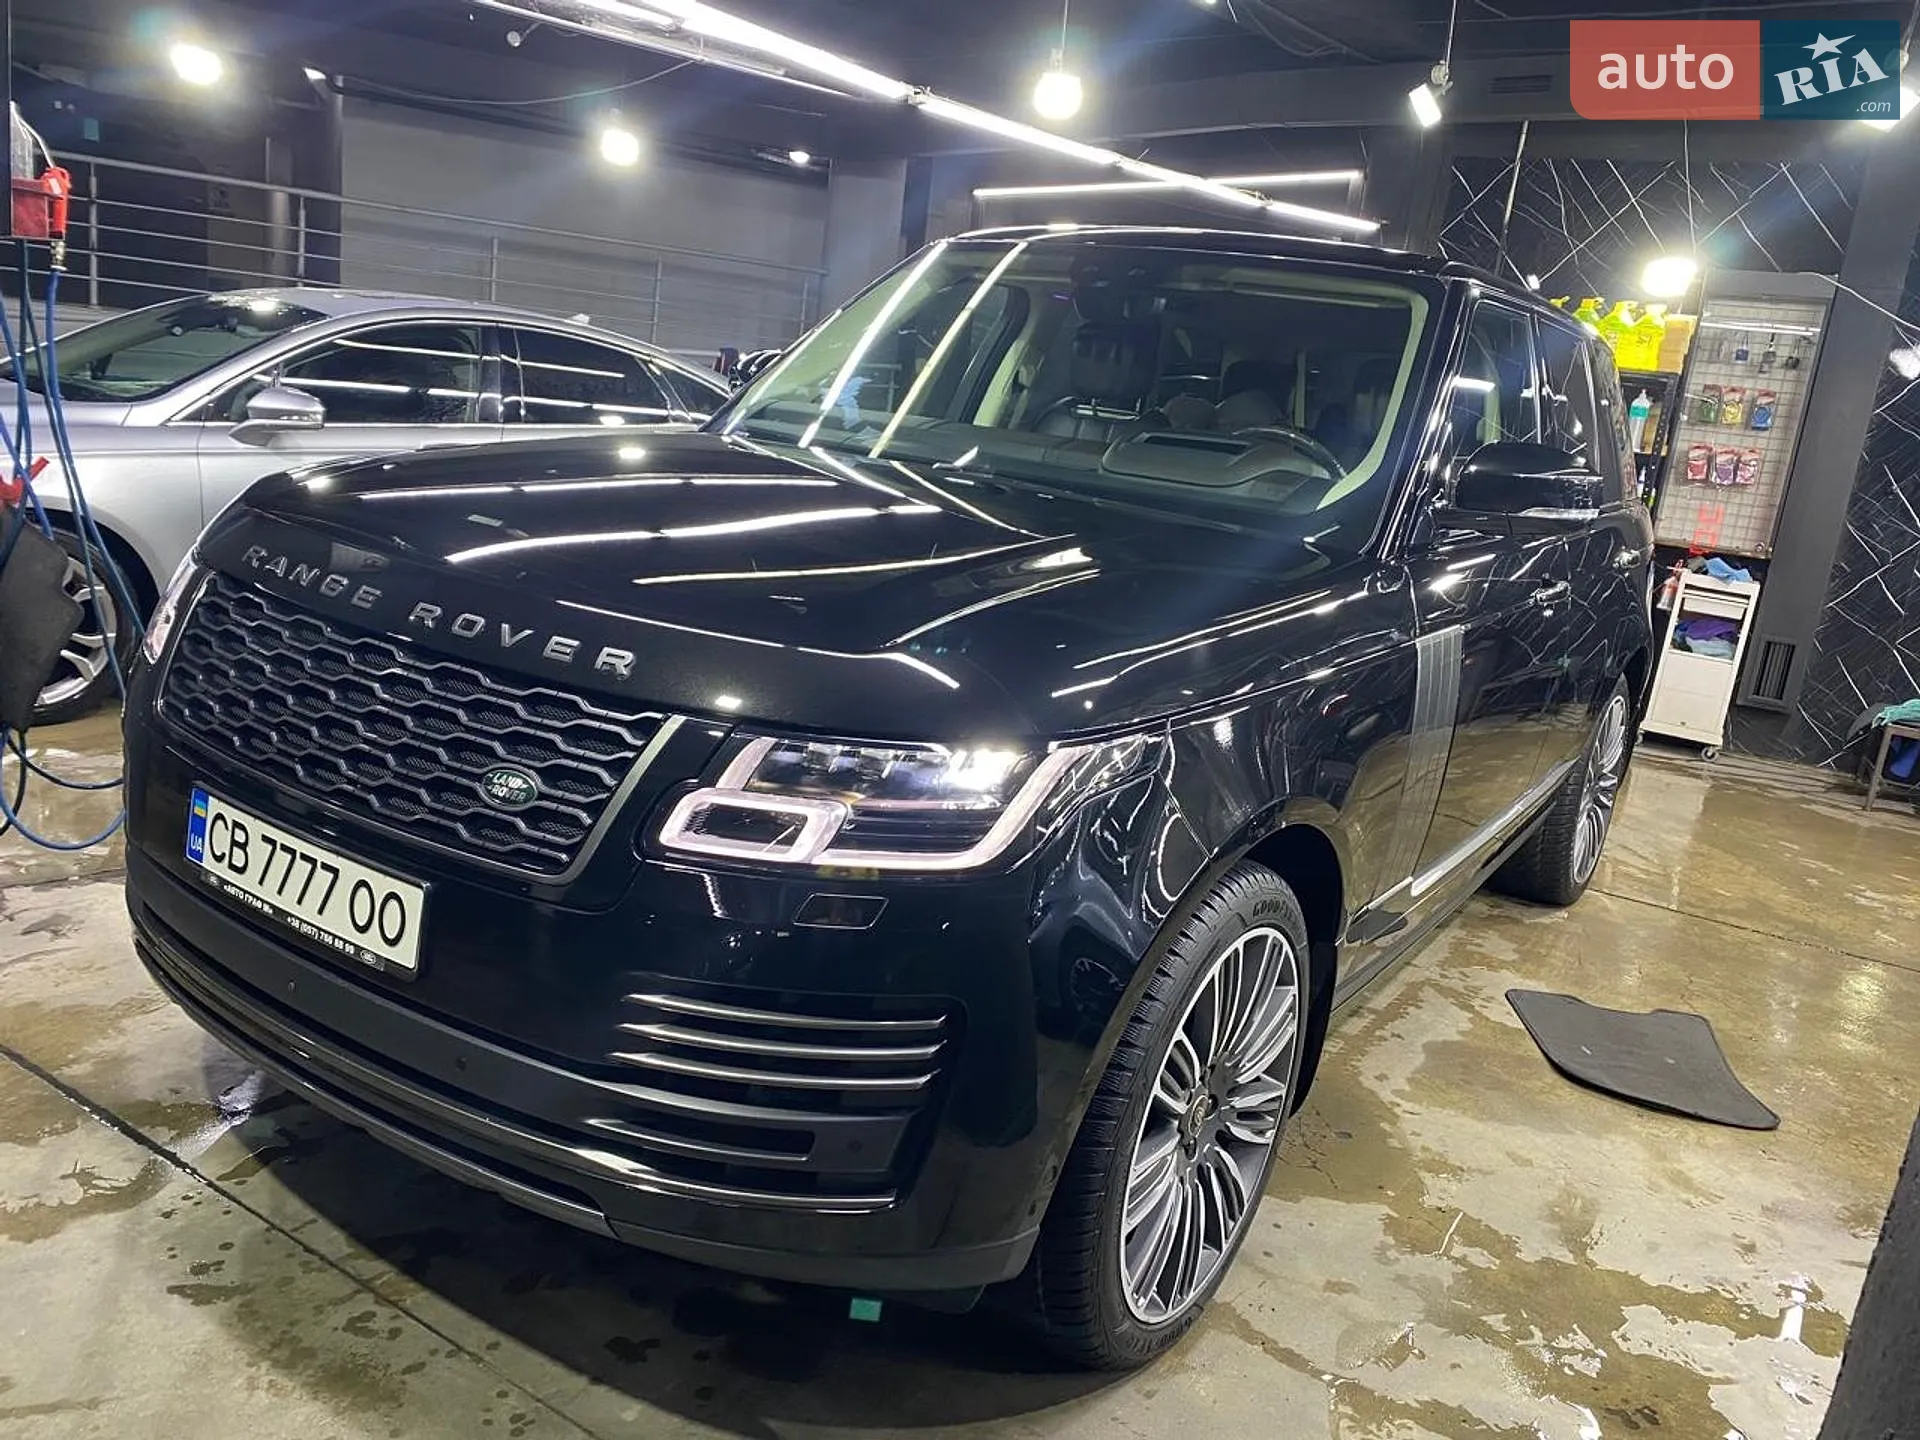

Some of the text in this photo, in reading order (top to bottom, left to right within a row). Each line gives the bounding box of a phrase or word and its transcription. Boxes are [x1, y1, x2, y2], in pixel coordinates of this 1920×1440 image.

[241, 545, 637, 680] RANGE ROVER
[492, 772, 523, 789] LAND
[490, 784, 527, 801] ROVER
[190, 833, 202, 853] UA
[209, 812, 249, 875] CB
[258, 833, 340, 916] 7777
